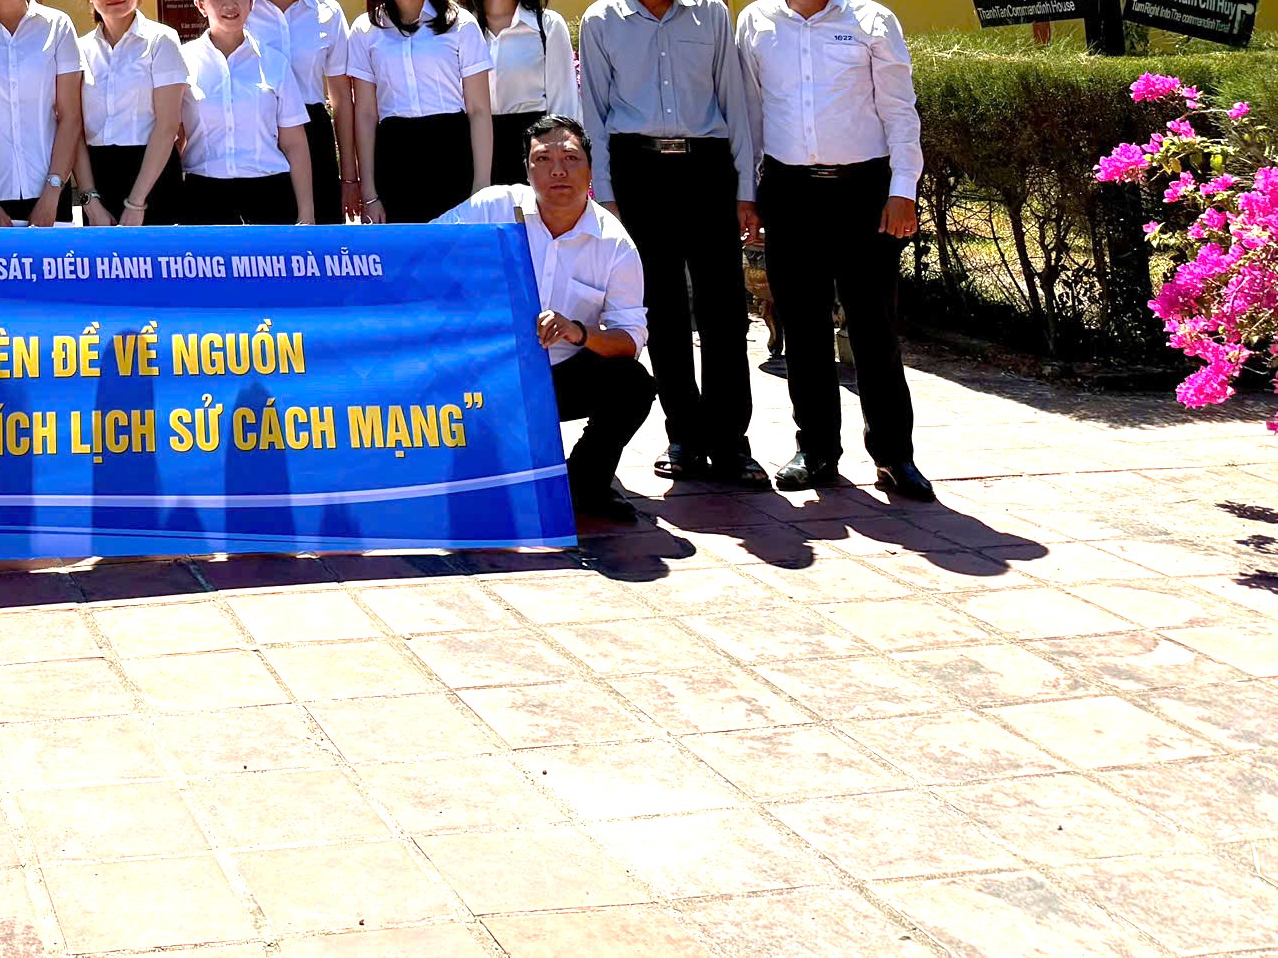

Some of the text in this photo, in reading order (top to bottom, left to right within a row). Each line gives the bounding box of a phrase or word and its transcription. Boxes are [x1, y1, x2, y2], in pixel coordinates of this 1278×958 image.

[43, 251, 89, 278] ĐIỀU
[97, 253, 152, 278] HÀNH
[158, 253, 225, 277] THÔNG
[232, 256, 286, 277] MINH
[292, 251, 320, 276] ĐÀ
[325, 248, 382, 275] NẴNG
[52, 322, 100, 377] ĐỀ
[114, 321, 159, 375] VỀ
[172, 319, 305, 374] NGUỒN
[71, 410, 155, 462] LỊCH
[170, 394, 223, 451] SỬ
[233, 398, 336, 450] CÁCH
[348, 392, 482, 457] MẠNG”
